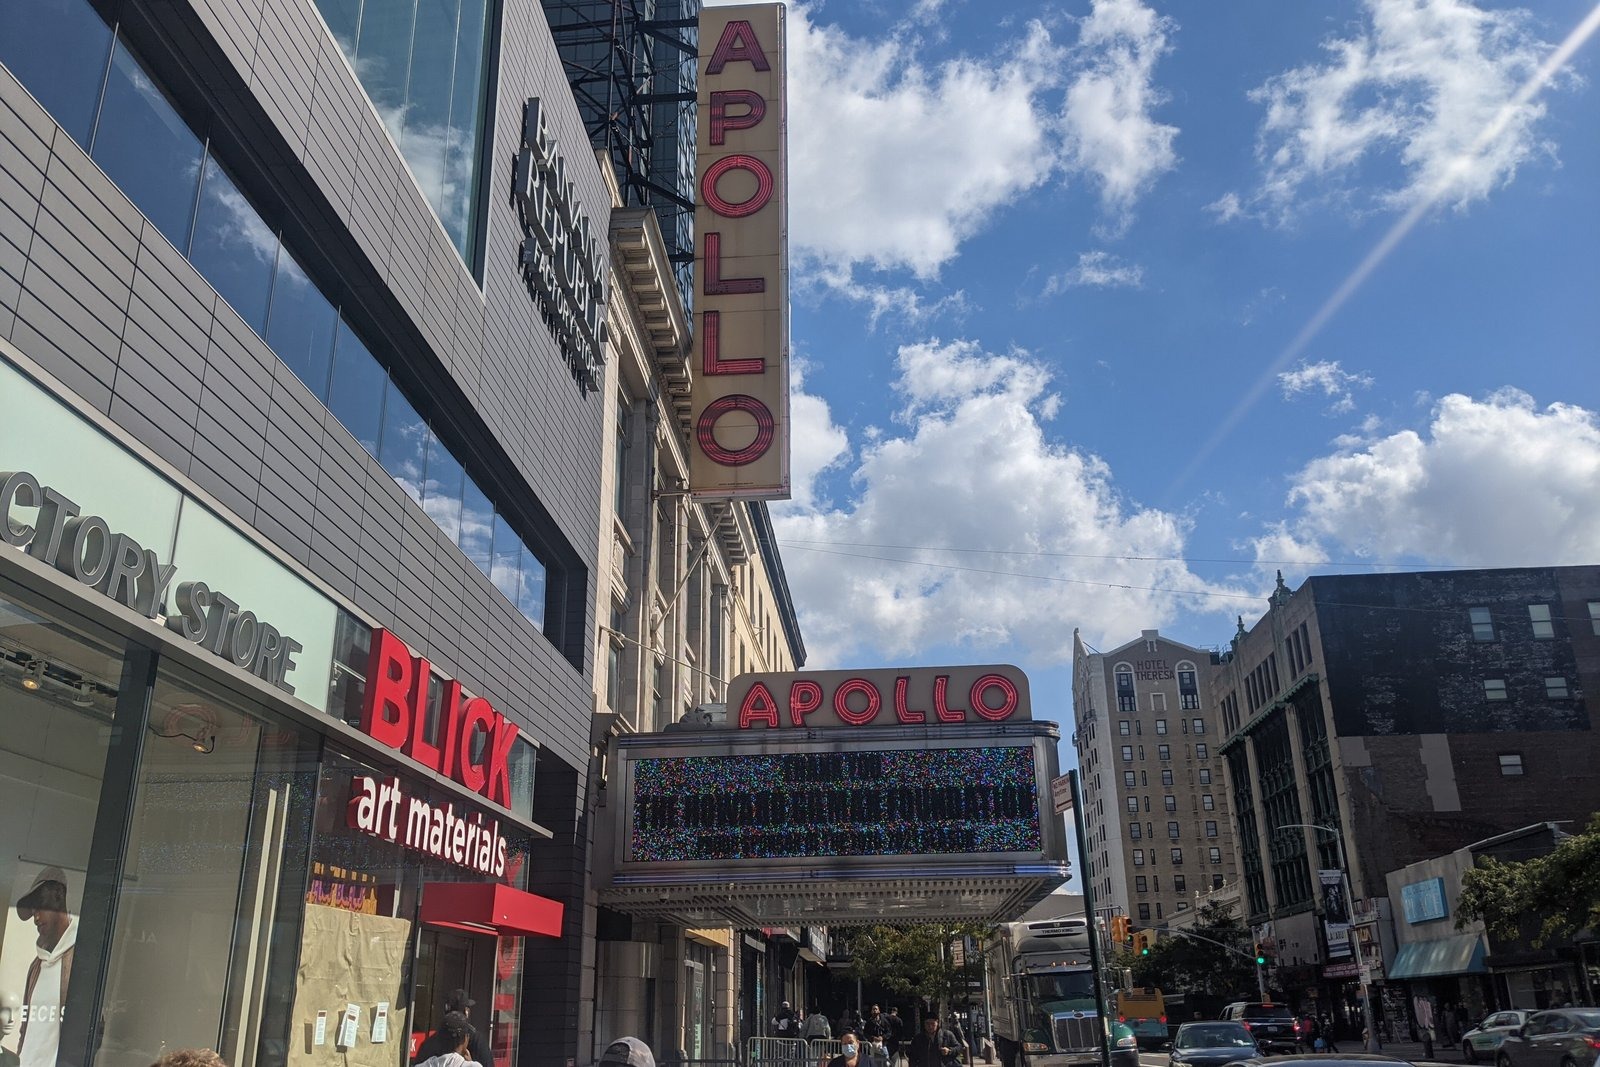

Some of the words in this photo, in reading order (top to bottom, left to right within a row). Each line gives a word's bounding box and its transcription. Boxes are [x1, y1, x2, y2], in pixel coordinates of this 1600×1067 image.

[520, 148, 608, 365] REPUBLIC
[529, 97, 604, 302] BANANA
[697, 20, 774, 467] APOLLO
[528, 239, 577, 335] FACTORY
[573, 328, 601, 388] STORE
[0, 471, 178, 620] CTORY
[172, 581, 303, 695] STORE
[1137, 660, 1170, 670] HOTEL
[365, 628, 519, 810] BLICK
[738, 674, 1018, 729] APOLLO
[1135, 670, 1175, 680] THERESA
[356, 777, 401, 840] art
[405, 796, 506, 877] materials
